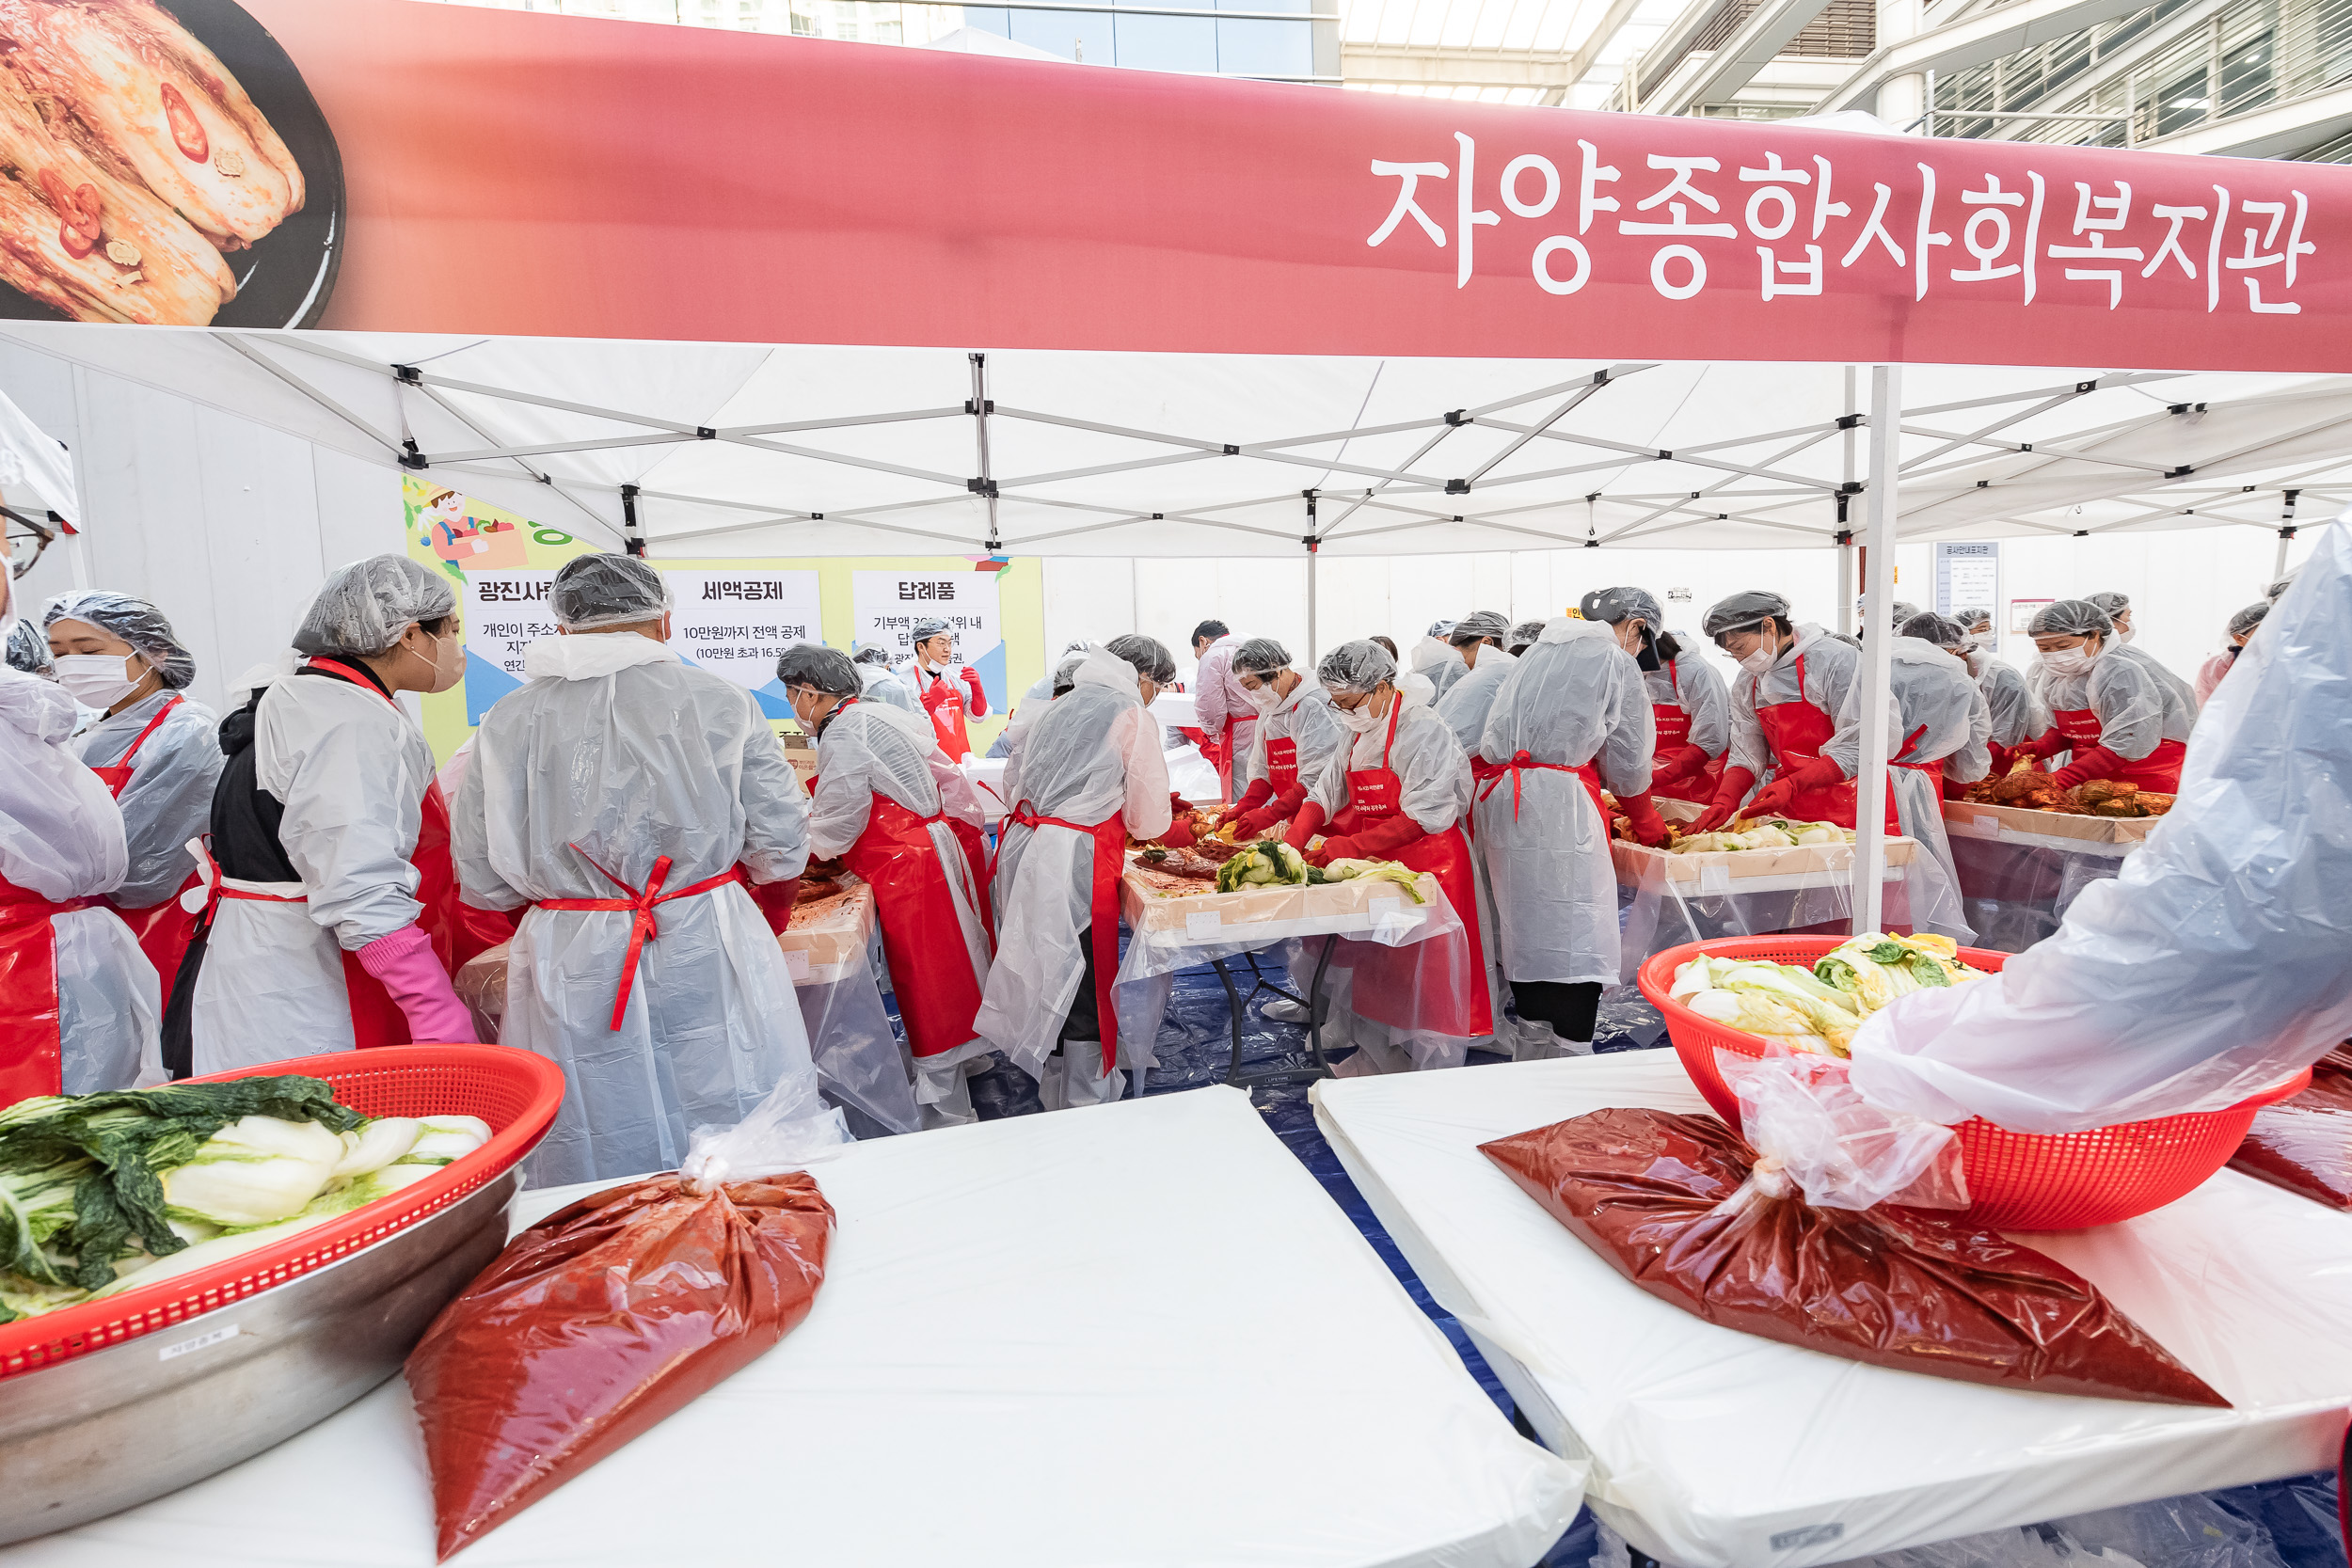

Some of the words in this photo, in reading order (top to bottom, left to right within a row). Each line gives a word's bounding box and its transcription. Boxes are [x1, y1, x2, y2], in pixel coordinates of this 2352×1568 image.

[1366, 131, 2317, 315] 자양종합사회복지관
[1947, 546, 1989, 555] 공사안내표지판
[702, 580, 783, 601] 세액공제
[898, 581, 956, 600] 답례품
[483, 623, 523, 638] 개인이
[874, 616, 910, 630] 기부액
[970, 616, 982, 629] 내
[683, 625, 749, 640] 10만원까지
[753, 625, 777, 639] 전액
[780, 625, 806, 639] 공제
[696, 647, 735, 659] (10만원
[737, 647, 758, 659] 초과
